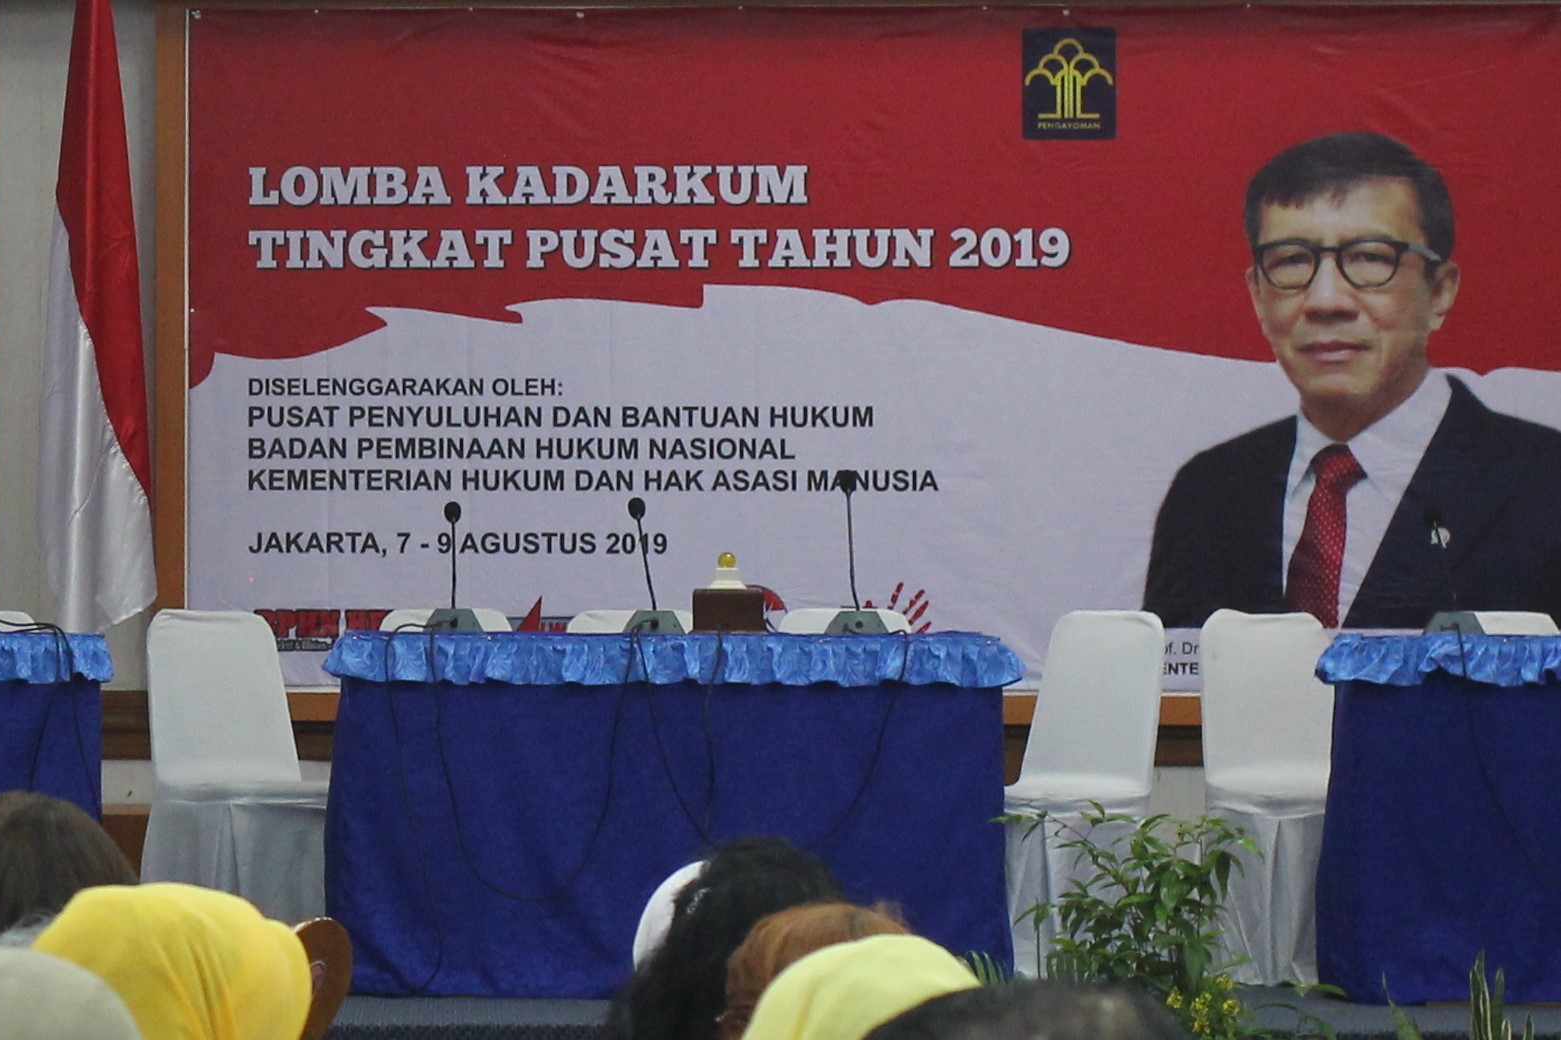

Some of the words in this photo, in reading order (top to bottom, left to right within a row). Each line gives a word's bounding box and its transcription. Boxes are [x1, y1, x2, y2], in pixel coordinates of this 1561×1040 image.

[248, 165, 452, 206] LOMBA
[465, 165, 808, 206] KADARKUM
[248, 229, 512, 269] TINGKAT
[526, 229, 717, 269] PUSAT
[730, 229, 935, 268] TAHUN
[949, 227, 1070, 268] 2019
[248, 378, 484, 397] DISELENGGARAKAN
[491, 378, 563, 397] OLEH:
[247, 406, 341, 428] PUSAT
[348, 406, 542, 428] PENYULUHAN
[552, 406, 611, 428] DAN
[621, 406, 759, 428] BANTUAN
[769, 406, 874, 428] HUKUM
[247, 438, 347, 460] BADAN
[357, 438, 526, 460] PEMBINAAN
[535, 438, 639, 460] HUKUM
[648, 438, 796, 460] NASIONAL
[247, 469, 452, 491] KEMENTERIAN
[461, 469, 565, 492] HUKUM
[575, 469, 634, 491] DAN
[644, 469, 705, 491] HAK
[711, 469, 797, 492] ASASI
[248, 532, 387, 558] JAKARTA,
[396, 532, 411, 554] 7
[438, 532, 453, 554] 9
[460, 532, 597, 554] AGUSTUS
[605, 532, 668, 554] 2019
